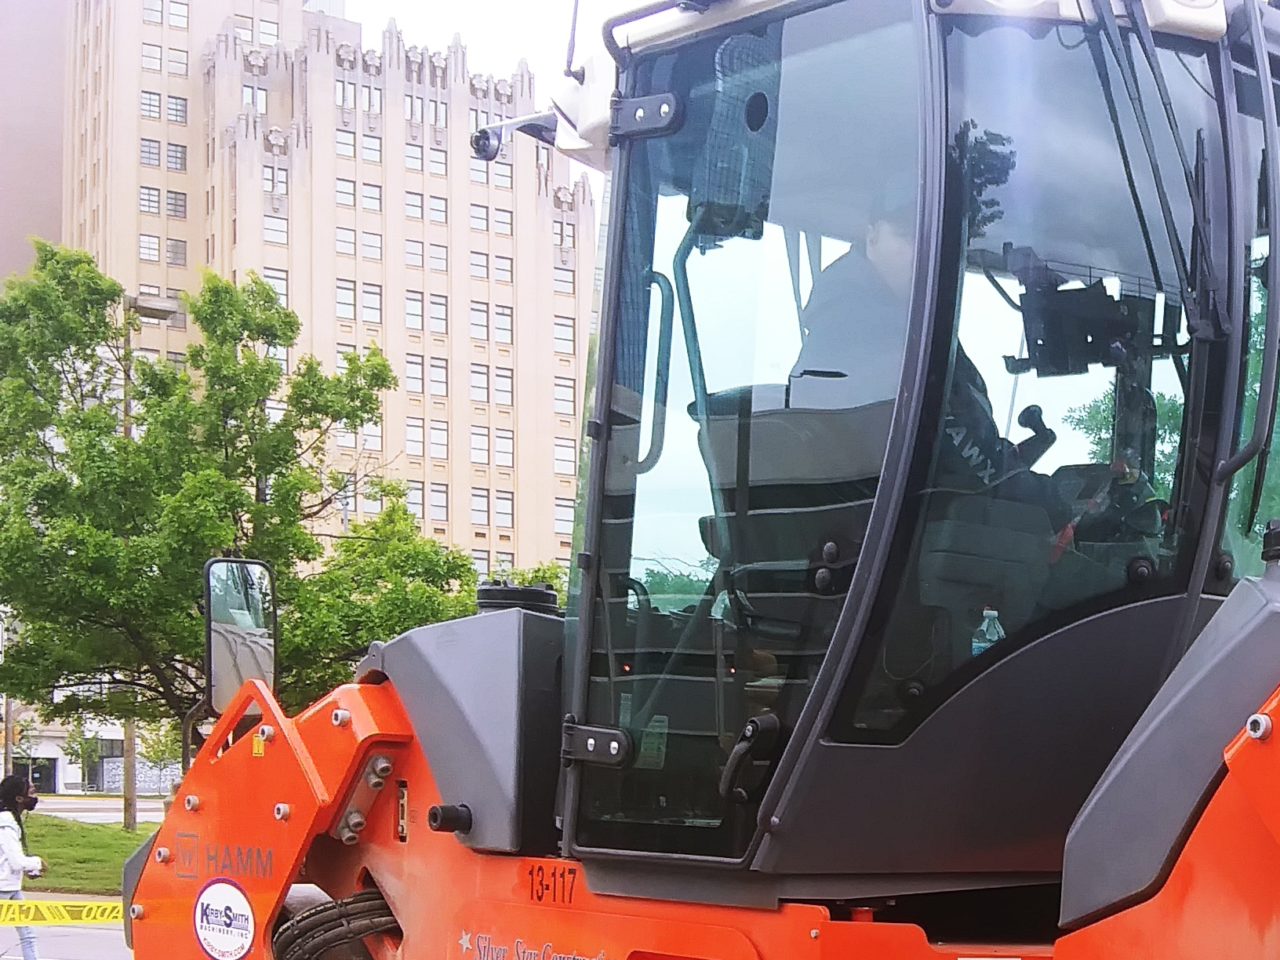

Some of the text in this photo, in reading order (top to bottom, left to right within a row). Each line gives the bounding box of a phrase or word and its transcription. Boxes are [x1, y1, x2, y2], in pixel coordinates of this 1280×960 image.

[944, 415, 996, 485] AWX
[206, 844, 273, 878] HAMM
[528, 865, 577, 904] 13-117
